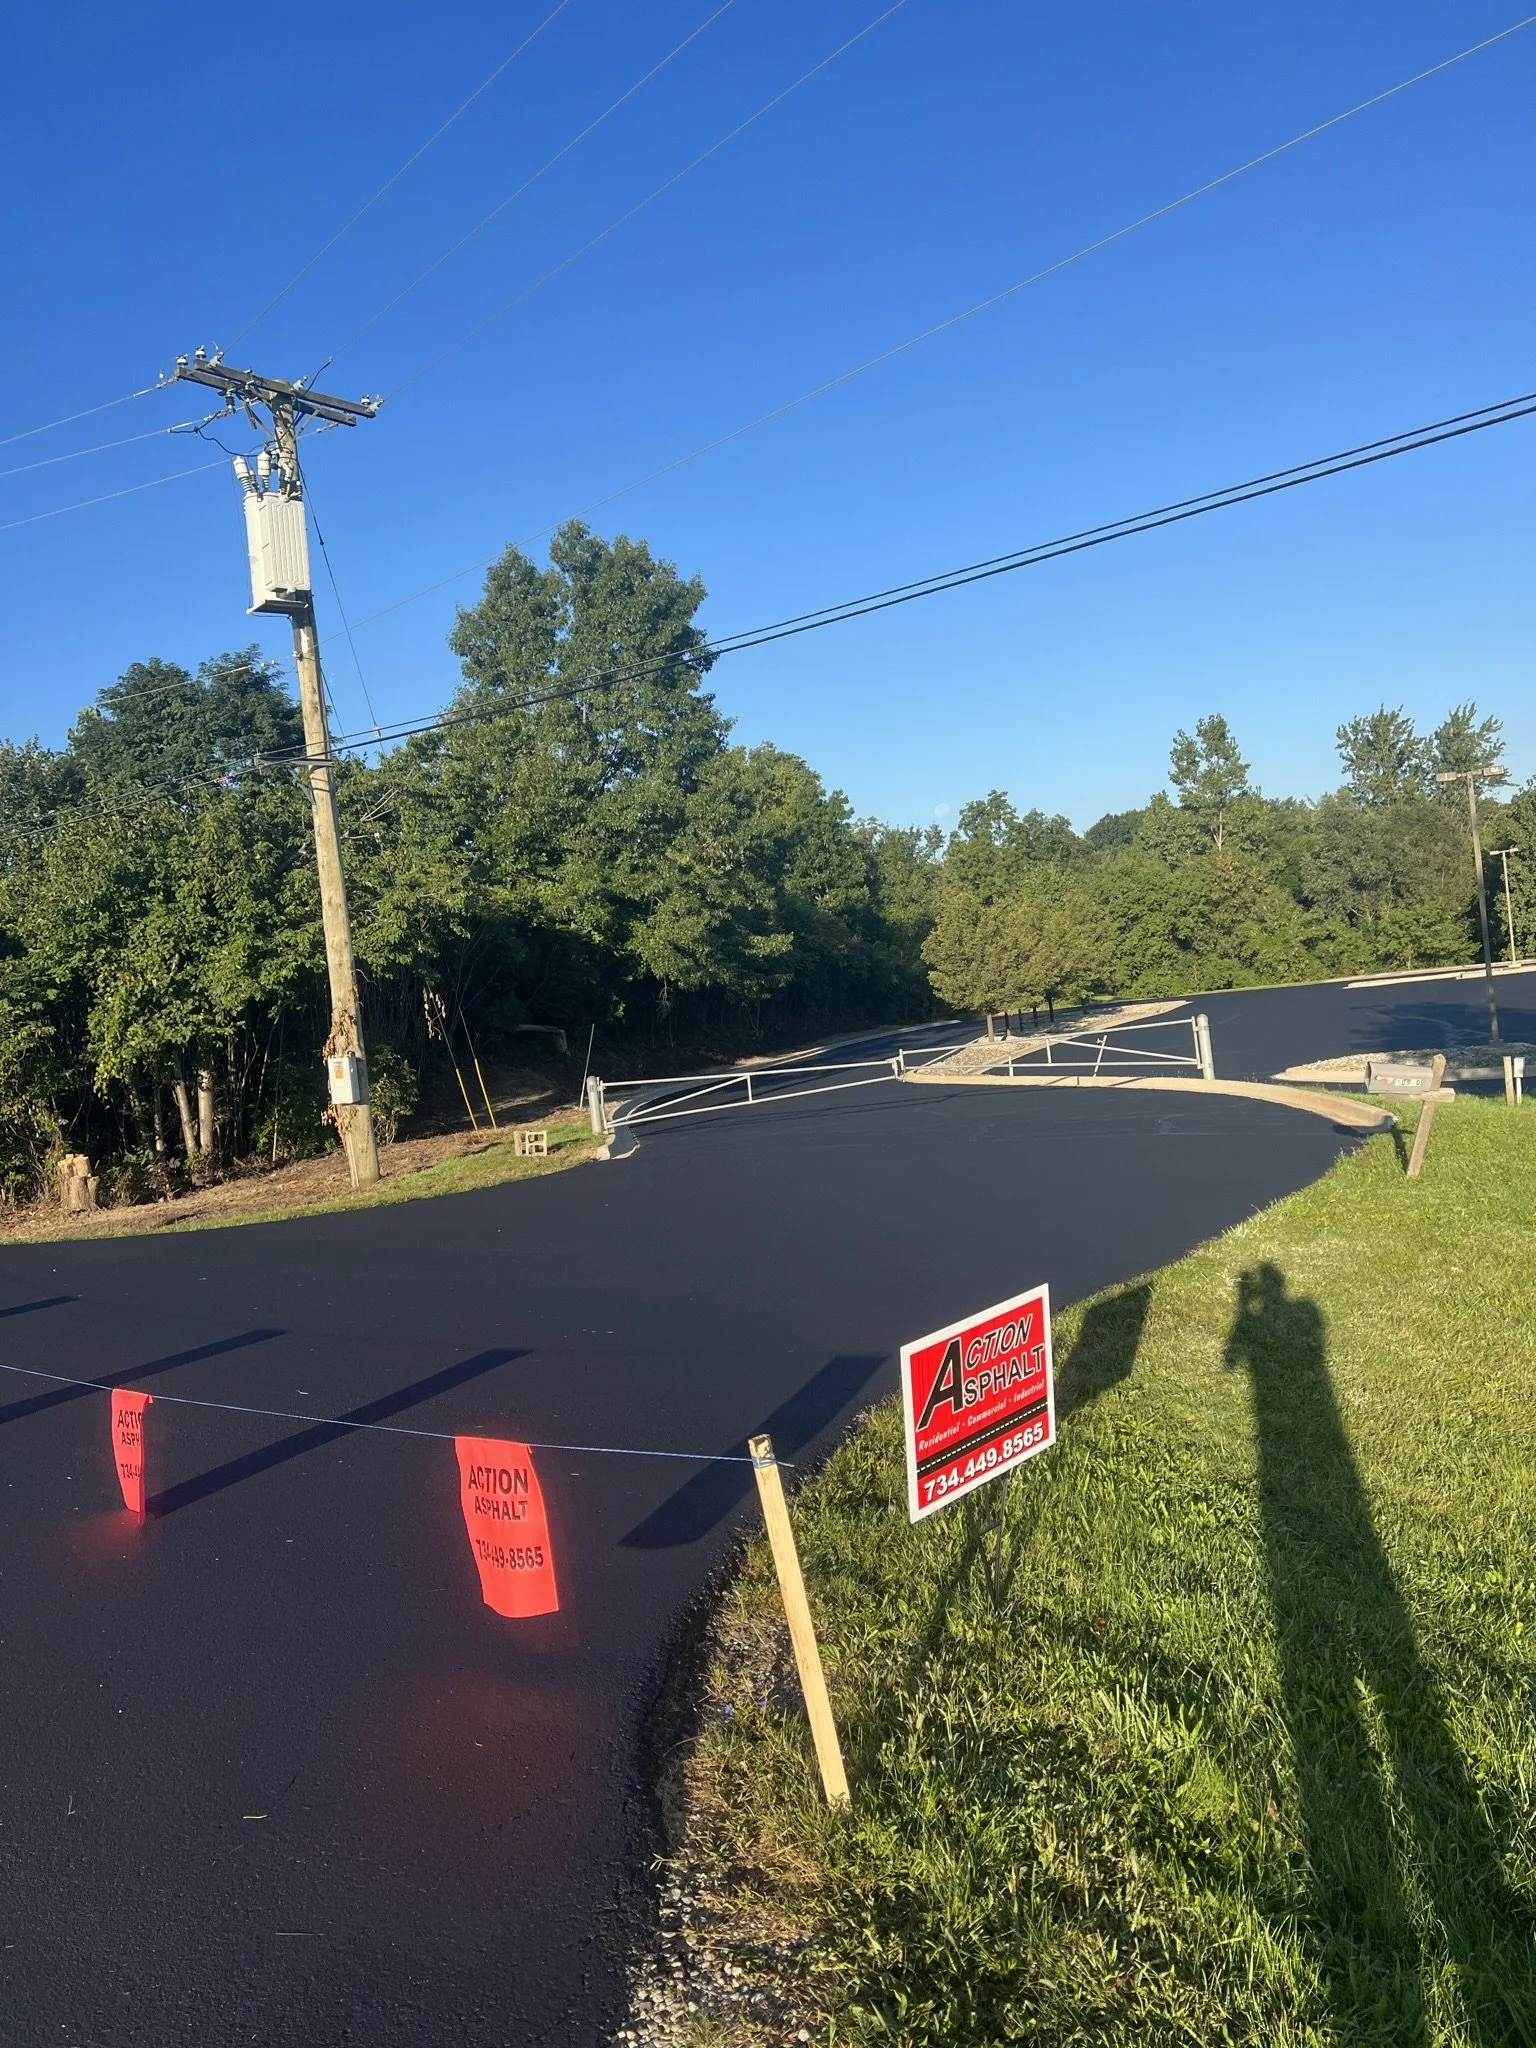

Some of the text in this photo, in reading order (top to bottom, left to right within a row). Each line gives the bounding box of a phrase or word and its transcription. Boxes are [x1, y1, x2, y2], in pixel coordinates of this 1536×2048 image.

[918, 1379, 1045, 1452] Residential Commercial Industrial
[468, 1464, 529, 1495] ACTION
[924, 1421, 1044, 1502] 734.449.8565
[475, 1495, 529, 1521] ASPHALT
